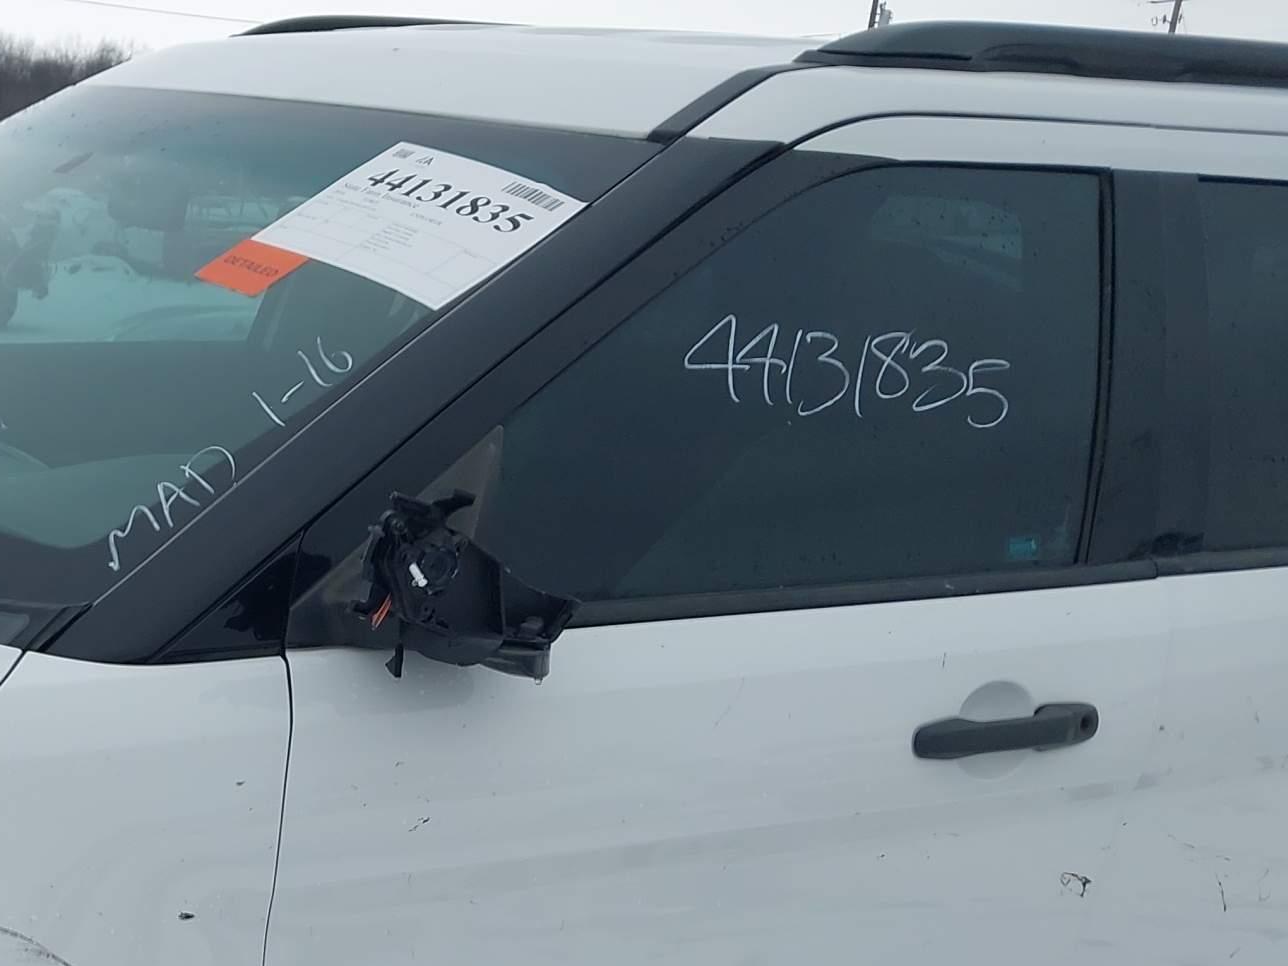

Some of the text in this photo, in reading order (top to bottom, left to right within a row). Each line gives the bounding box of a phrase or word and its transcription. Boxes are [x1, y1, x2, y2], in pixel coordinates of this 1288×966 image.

[367, 168, 536, 234] 44131835
[223, 254, 280, 278] DETAILED
[683, 313, 1011, 429] 44131835
[107, 336, 354, 571] MAD 1-16
